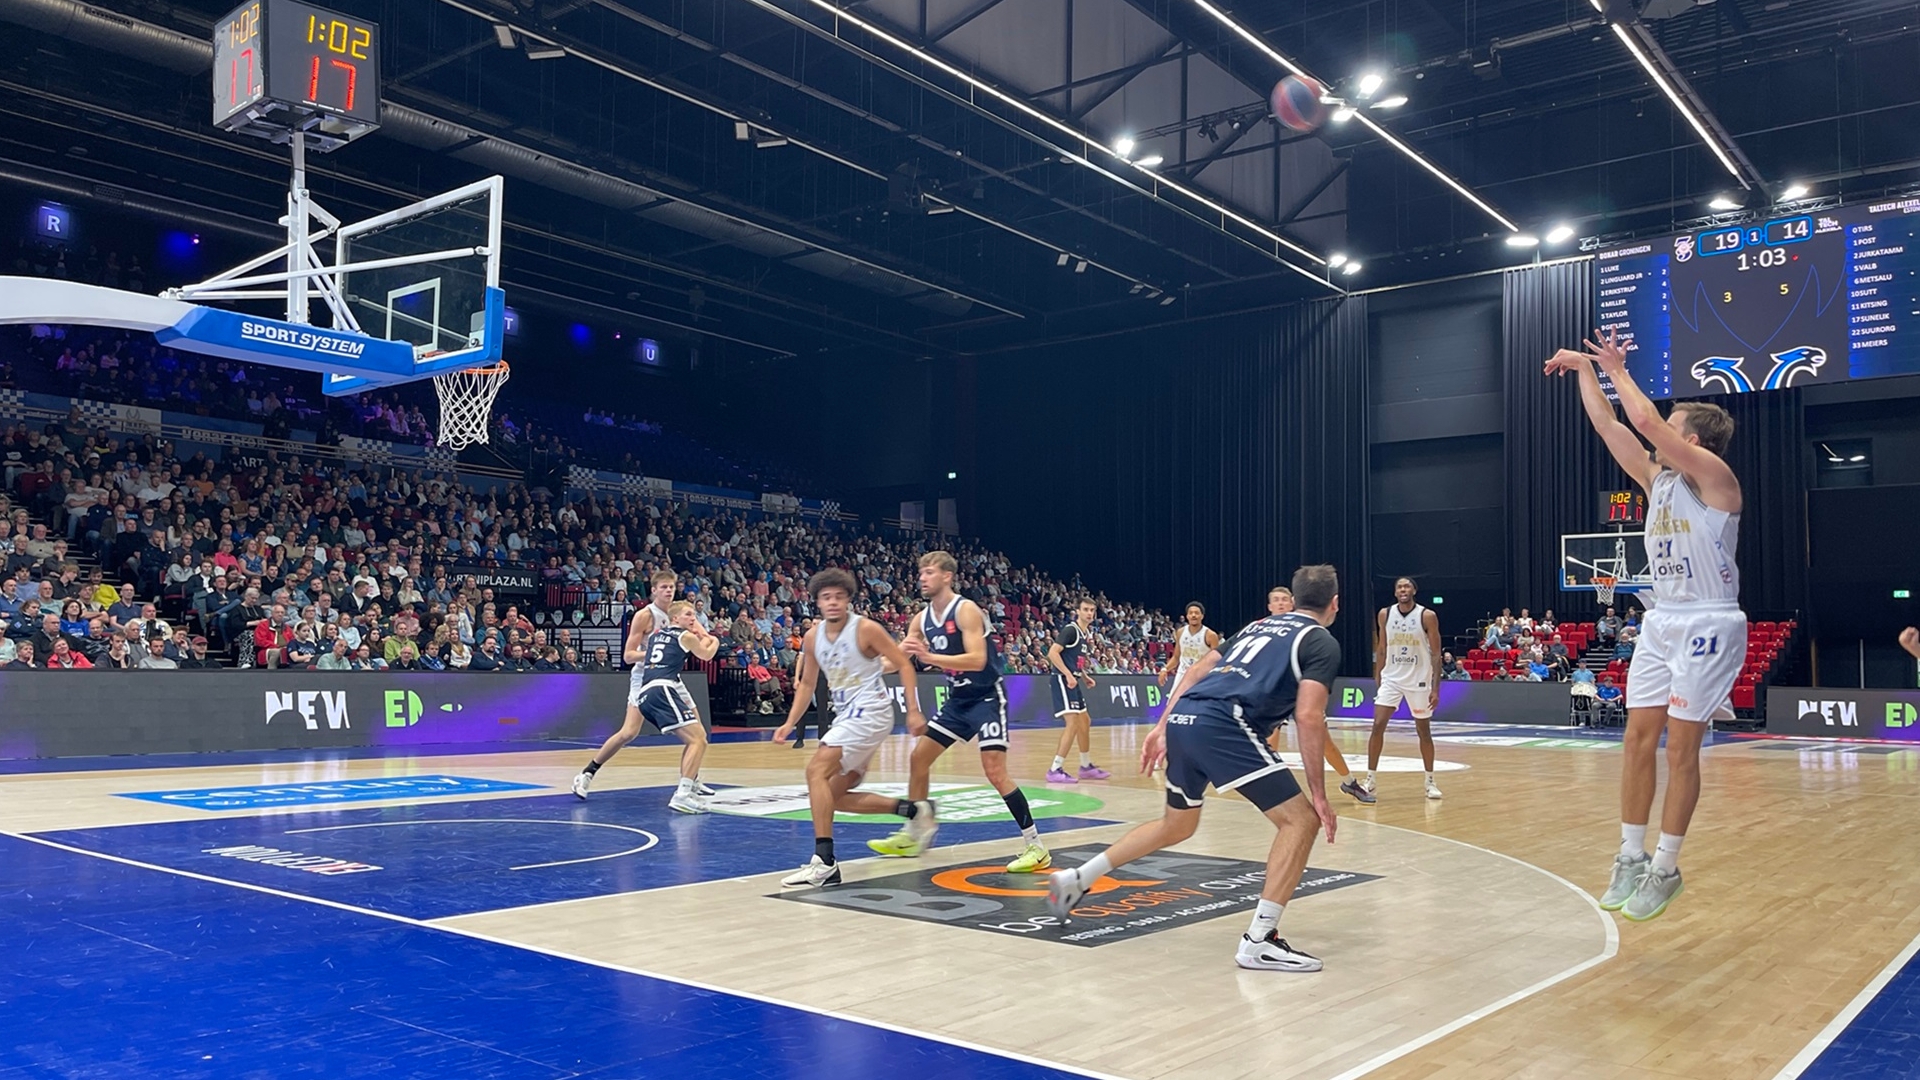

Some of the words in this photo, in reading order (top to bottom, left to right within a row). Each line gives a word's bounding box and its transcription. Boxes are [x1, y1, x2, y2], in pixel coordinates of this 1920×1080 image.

[231, 3, 260, 49] 1:02
[307, 15, 371, 60] 1:02
[231, 48, 253, 106] 17
[309, 55, 357, 111] 17
[47, 214, 61, 232] R
[1858, 225, 1873, 233] TIRS
[1714, 232, 1740, 251] 19
[1751, 231, 1758, 242] 1
[1783, 220, 1809, 240] 14
[1858, 237, 1876, 245] POST
[1737, 248, 1787, 271] 1:03
[1858, 246, 1903, 259] JURKATAMM
[1604, 265, 1620, 273] LUKE
[1858, 263, 1878, 271] VALB
[1859, 273, 1893, 284] METSALU
[1723, 291, 1732, 303] 3
[1779, 283, 1789, 295] 5
[1860, 288, 1878, 297] SUTT
[1605, 299, 1627, 308] MILLER
[1860, 300, 1888, 309] KITSING
[1605, 310, 1628, 319] TAYLOR
[504, 317, 513, 330] T
[1861, 325, 1896, 335] SUURORG
[241, 321, 299, 343] SPORT
[299, 333, 365, 355] SYSTEM
[1861, 339, 1888, 348] MEIERS
[646, 348, 655, 361] U
[1610, 492, 1631, 504] 1:02
[1609, 504, 1627, 521] 17
[932, 635, 948, 650] 10
[1225, 635, 1272, 664] 11
[1692, 635, 1718, 657] 21
[650, 643, 666, 663] 5
[1401, 647, 1408, 655] 2
[980, 721, 1001, 738] 10
[979, 916, 1072, 934] be
[1069, 886, 1213, 918] quality
